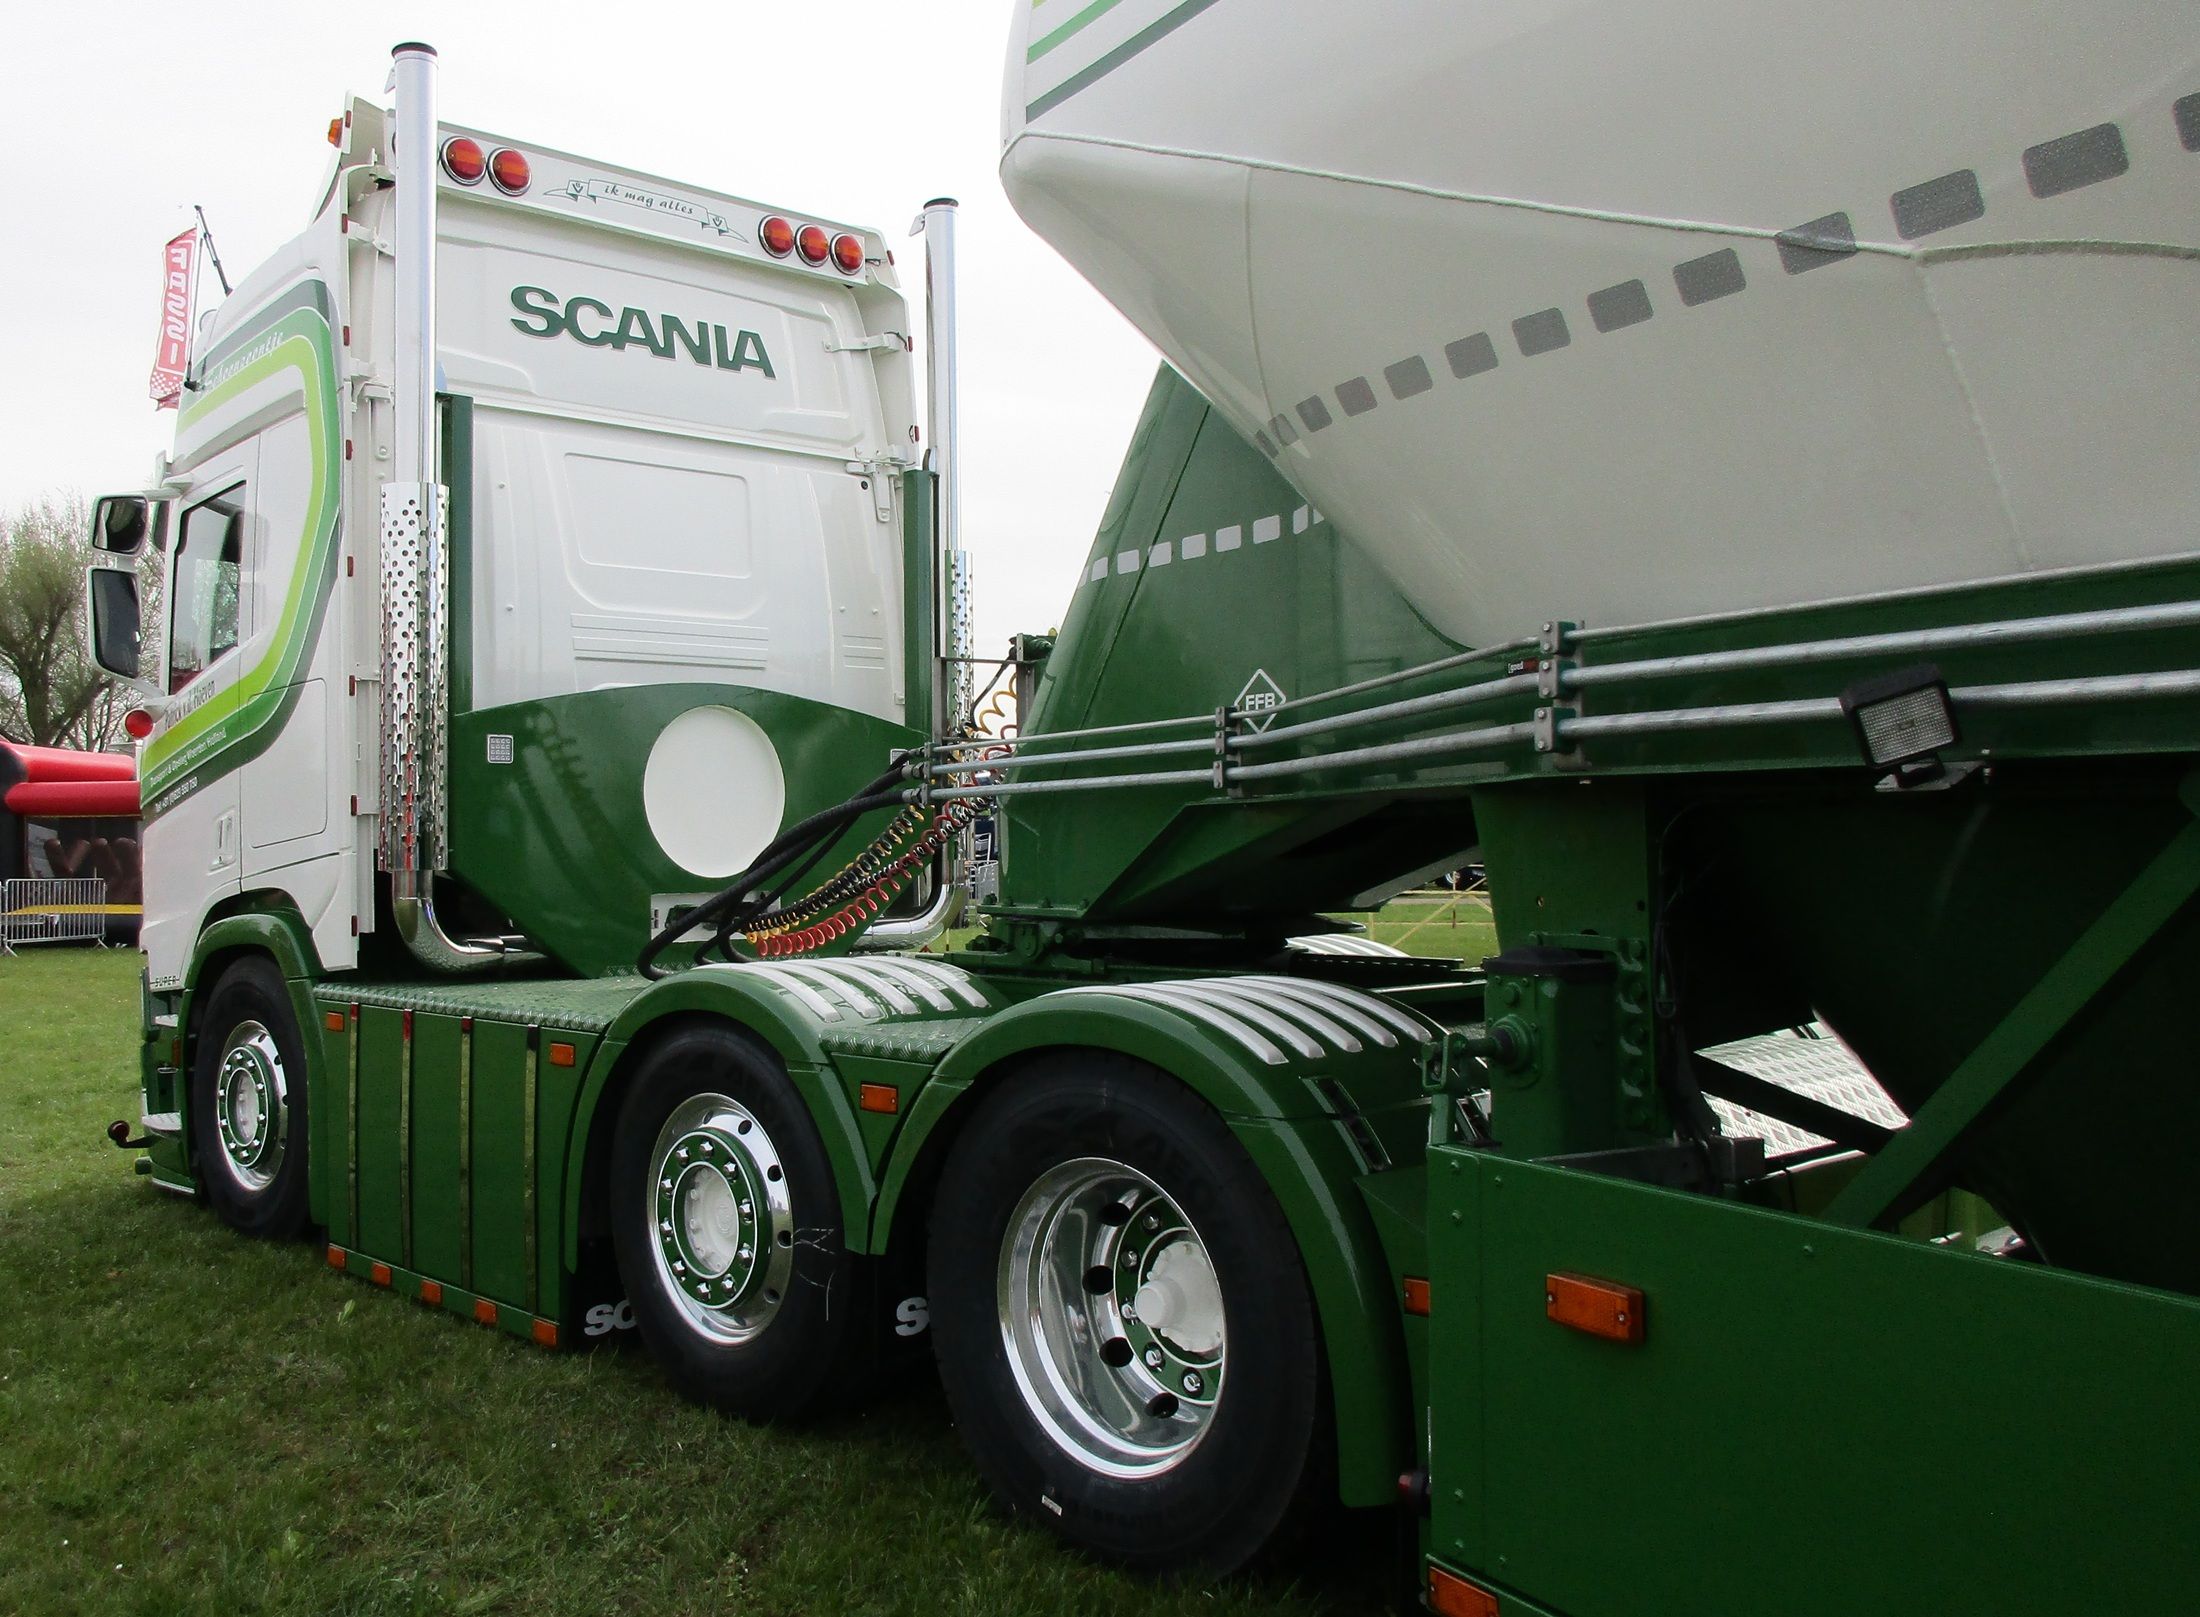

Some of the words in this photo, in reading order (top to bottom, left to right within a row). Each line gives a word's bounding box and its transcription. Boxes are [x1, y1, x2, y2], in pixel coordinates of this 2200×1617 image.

[604, 184, 619, 195] ik
[624, 192, 653, 208] mag
[659, 200, 694, 214] alles
[509, 284, 777, 379] SCANIA
[1245, 692, 1276, 711] FFB
